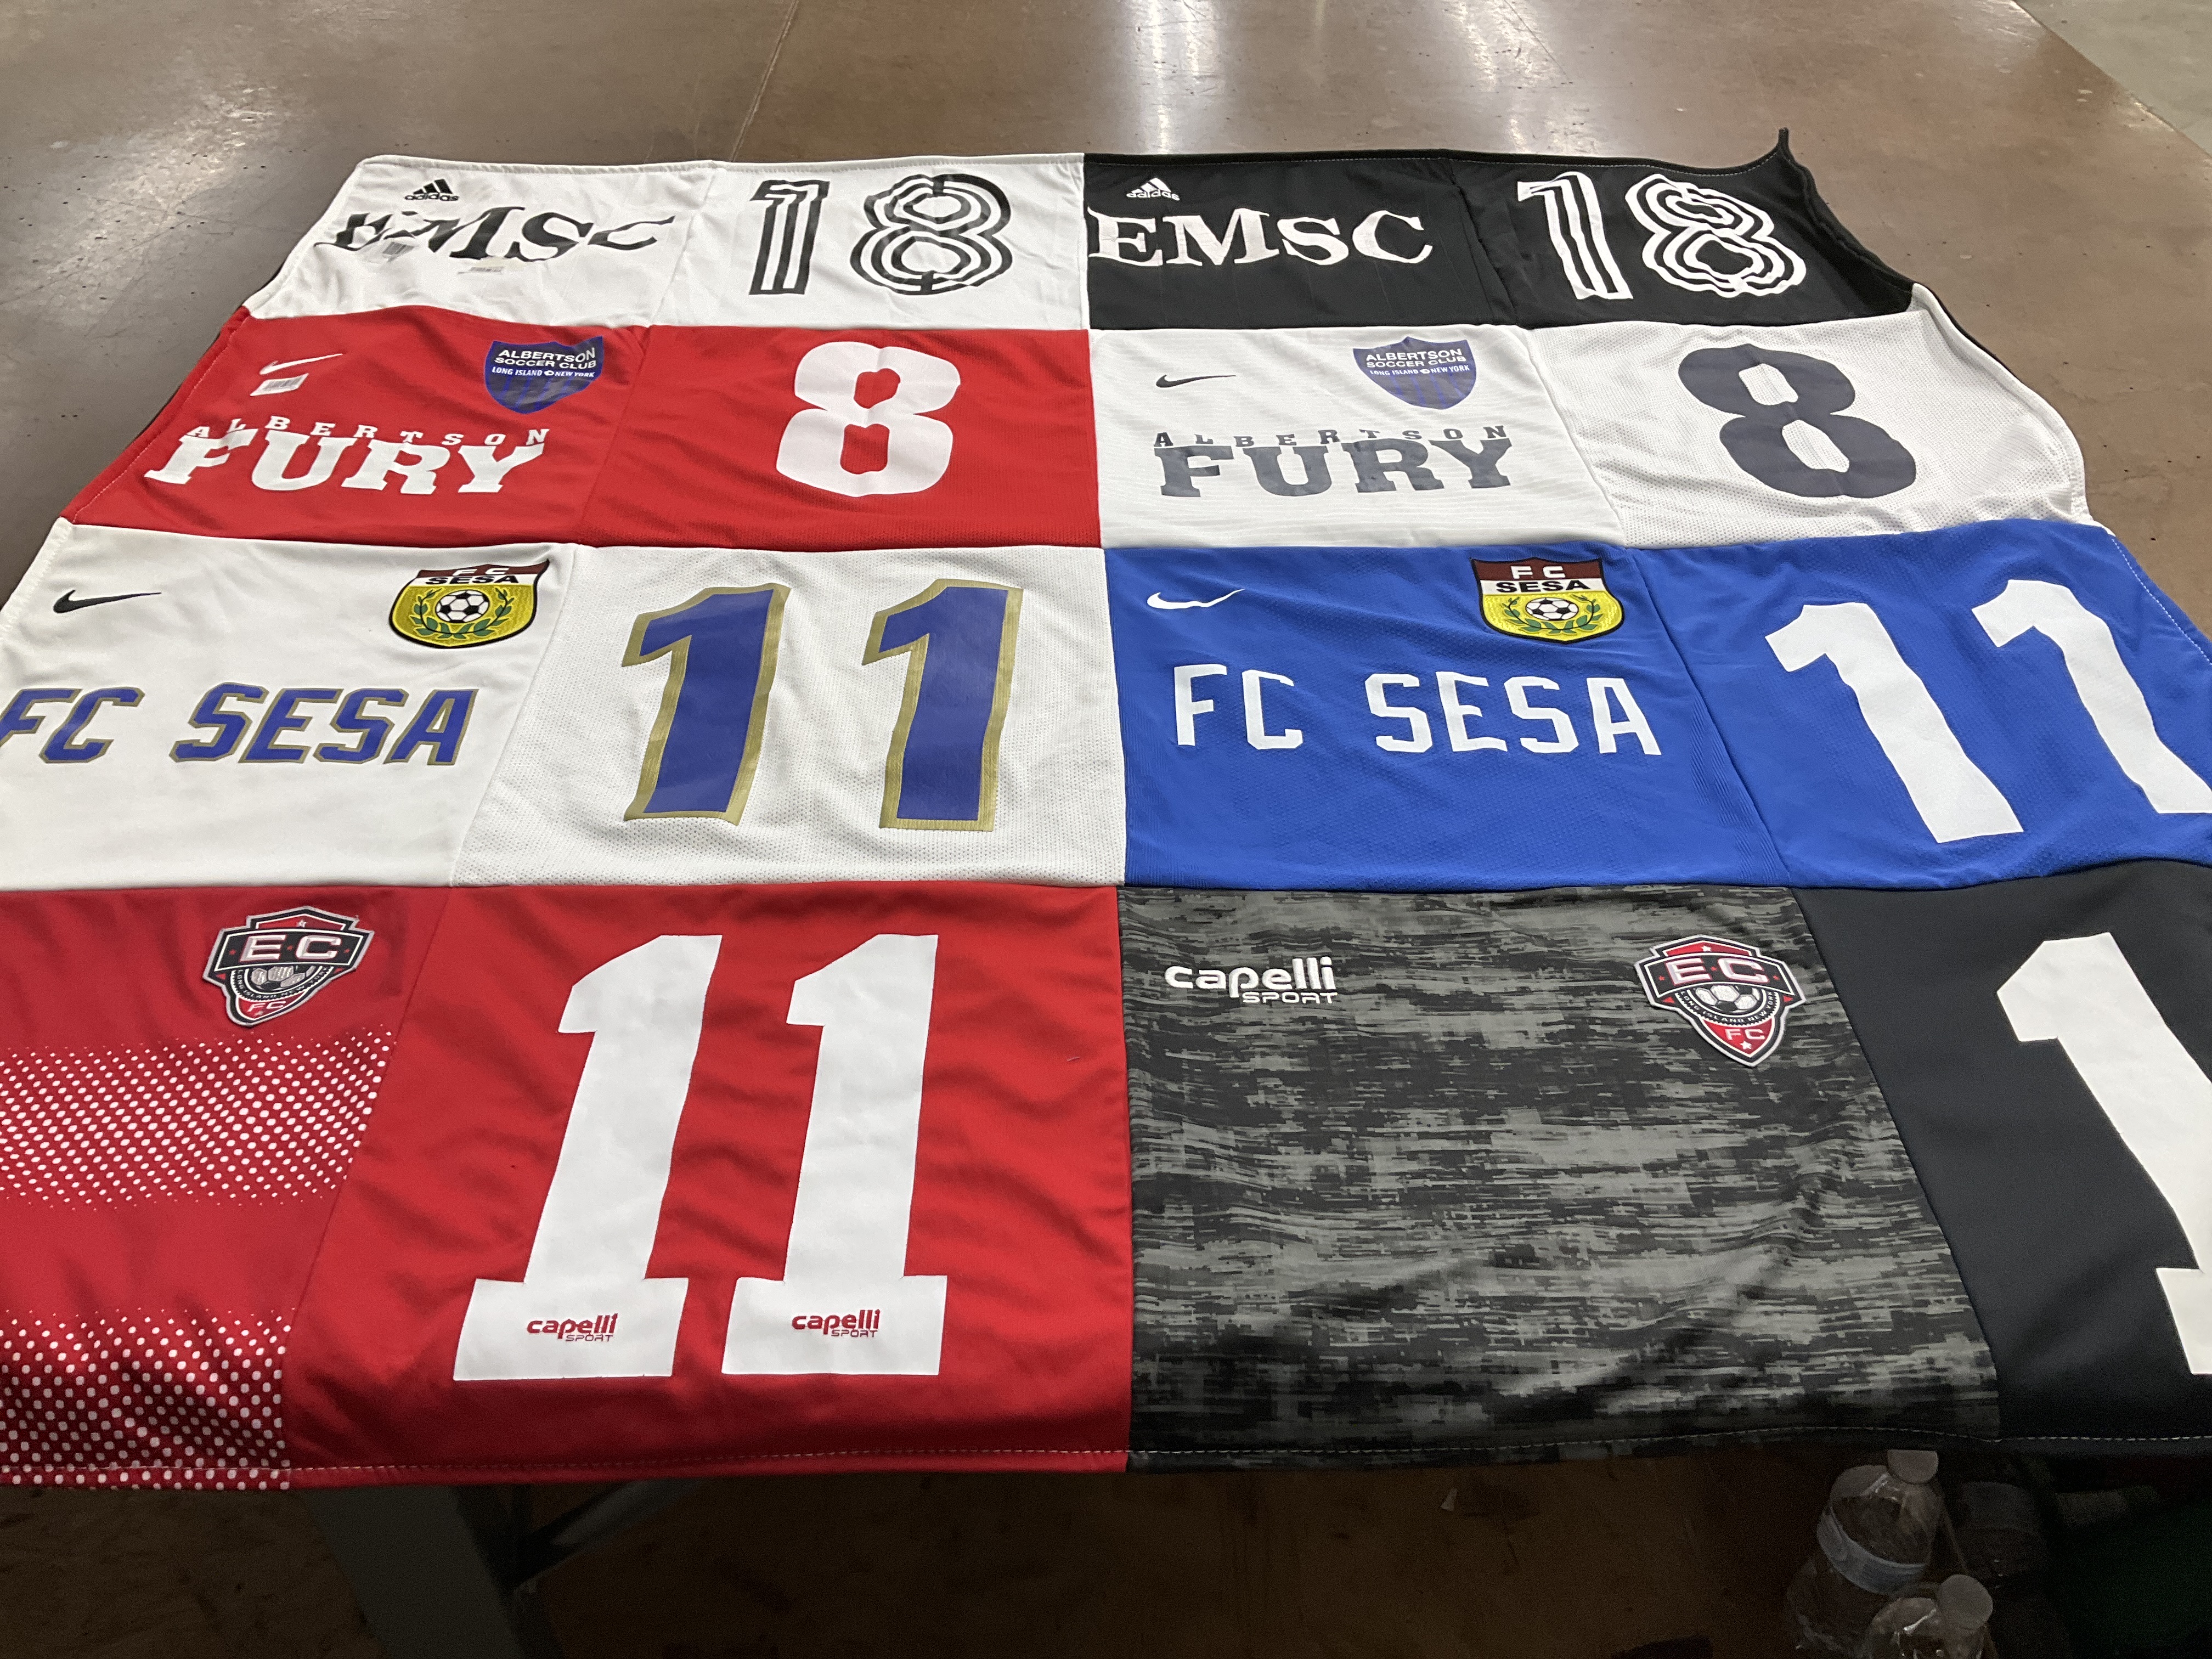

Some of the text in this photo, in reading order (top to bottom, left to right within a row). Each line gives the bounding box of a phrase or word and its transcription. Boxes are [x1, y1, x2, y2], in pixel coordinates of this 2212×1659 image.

[404, 192, 460, 201] adidas
[1126, 189, 1181, 201] adidas
[314, 206, 675, 263] EMSC
[748, 173, 1013, 296] 18
[1087, 206, 1433, 267] EMSC
[1517, 171, 1807, 300] 18
[494, 357, 597, 369] SOCCER CLUB
[498, 347, 596, 363] ALBERTSON
[1366, 348, 1463, 362] ALBERTSON
[1366, 356, 1466, 368] SOCCER CLUB
[1448, 364, 1470, 373] YORK
[492, 366, 513, 375] LONG
[186, 415, 549, 446] ALBERTSON
[776, 341, 961, 498] 8
[1678, 343, 1916, 499] 8
[1154, 425, 1506, 447] ALBERTSON
[144, 428, 546, 495] FURY
[1154, 438, 1513, 498] FURY
[426, 575, 519, 585] SESA
[452, 567, 509, 576] FC
[1510, 566, 1566, 579] FC
[1496, 580, 1590, 593] SESA
[621, 578, 1024, 832] 11
[1173, 664, 1662, 755] FC SESA
[1764, 579, 2212, 844] 11
[0, 682, 479, 766] FC SESA
[1164, 956, 1337, 998] capelli
[248, 1001, 286, 1012] FC
[1242, 991, 1338, 1004] SPORT
[1680, 991, 1774, 1023] LONG ISLAND NEW YORK
[1724, 1029, 1766, 1041] FC
[453, 934, 947, 1381] 11
[1996, 932, 2212, 1375] 1
[527, 1312, 619, 1339] capelli
[792, 1308, 881, 1335] capelli
[831, 1329, 878, 1338] SPORT
